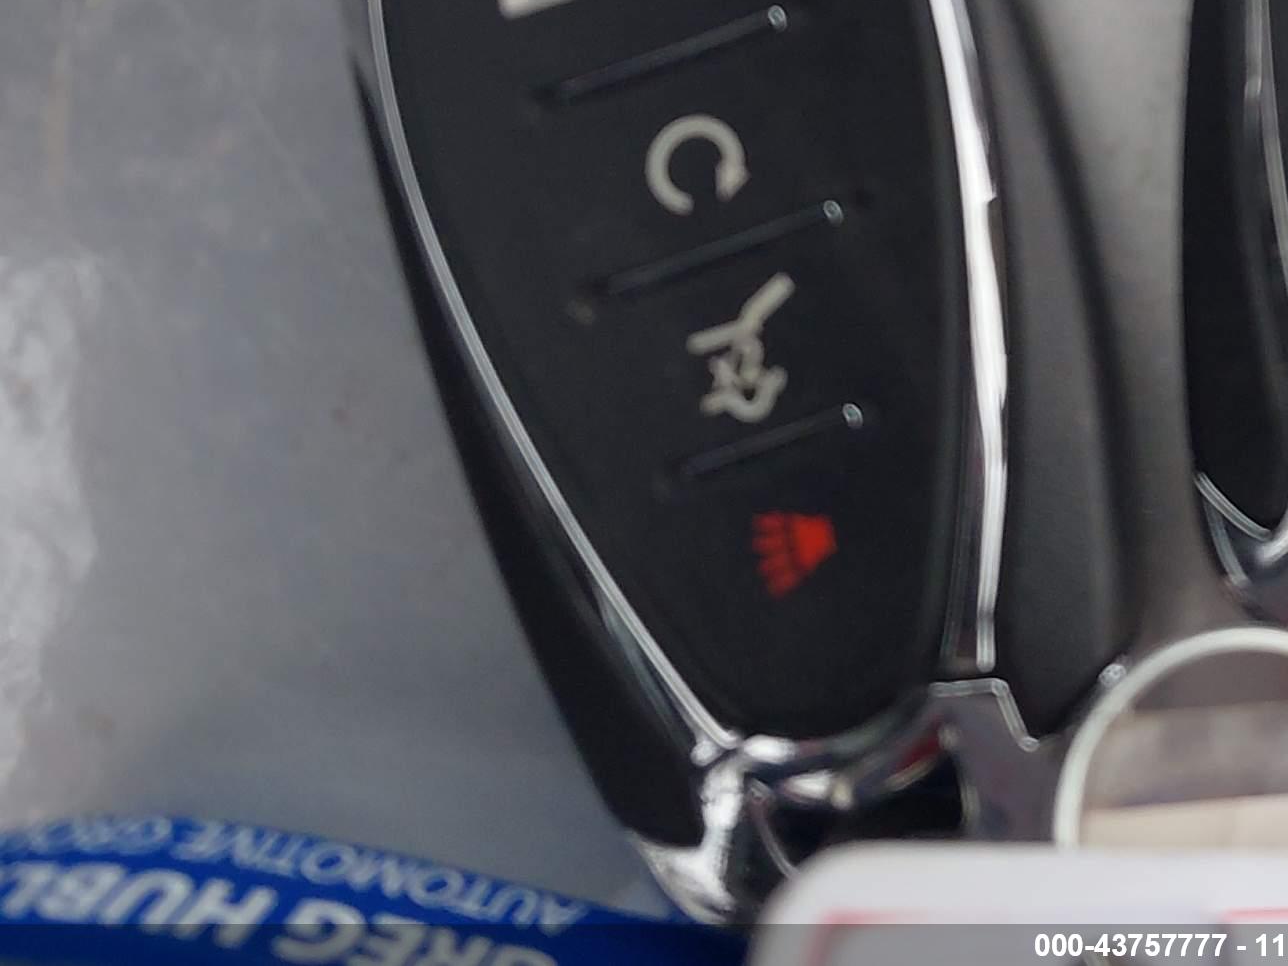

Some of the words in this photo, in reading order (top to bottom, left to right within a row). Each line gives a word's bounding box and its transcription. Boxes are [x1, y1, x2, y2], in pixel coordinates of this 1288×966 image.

[0, 815, 172, 856] GRO
[169, 819, 587, 936] AUTOMOTIVE
[0, 860, 279, 948] HUBL
